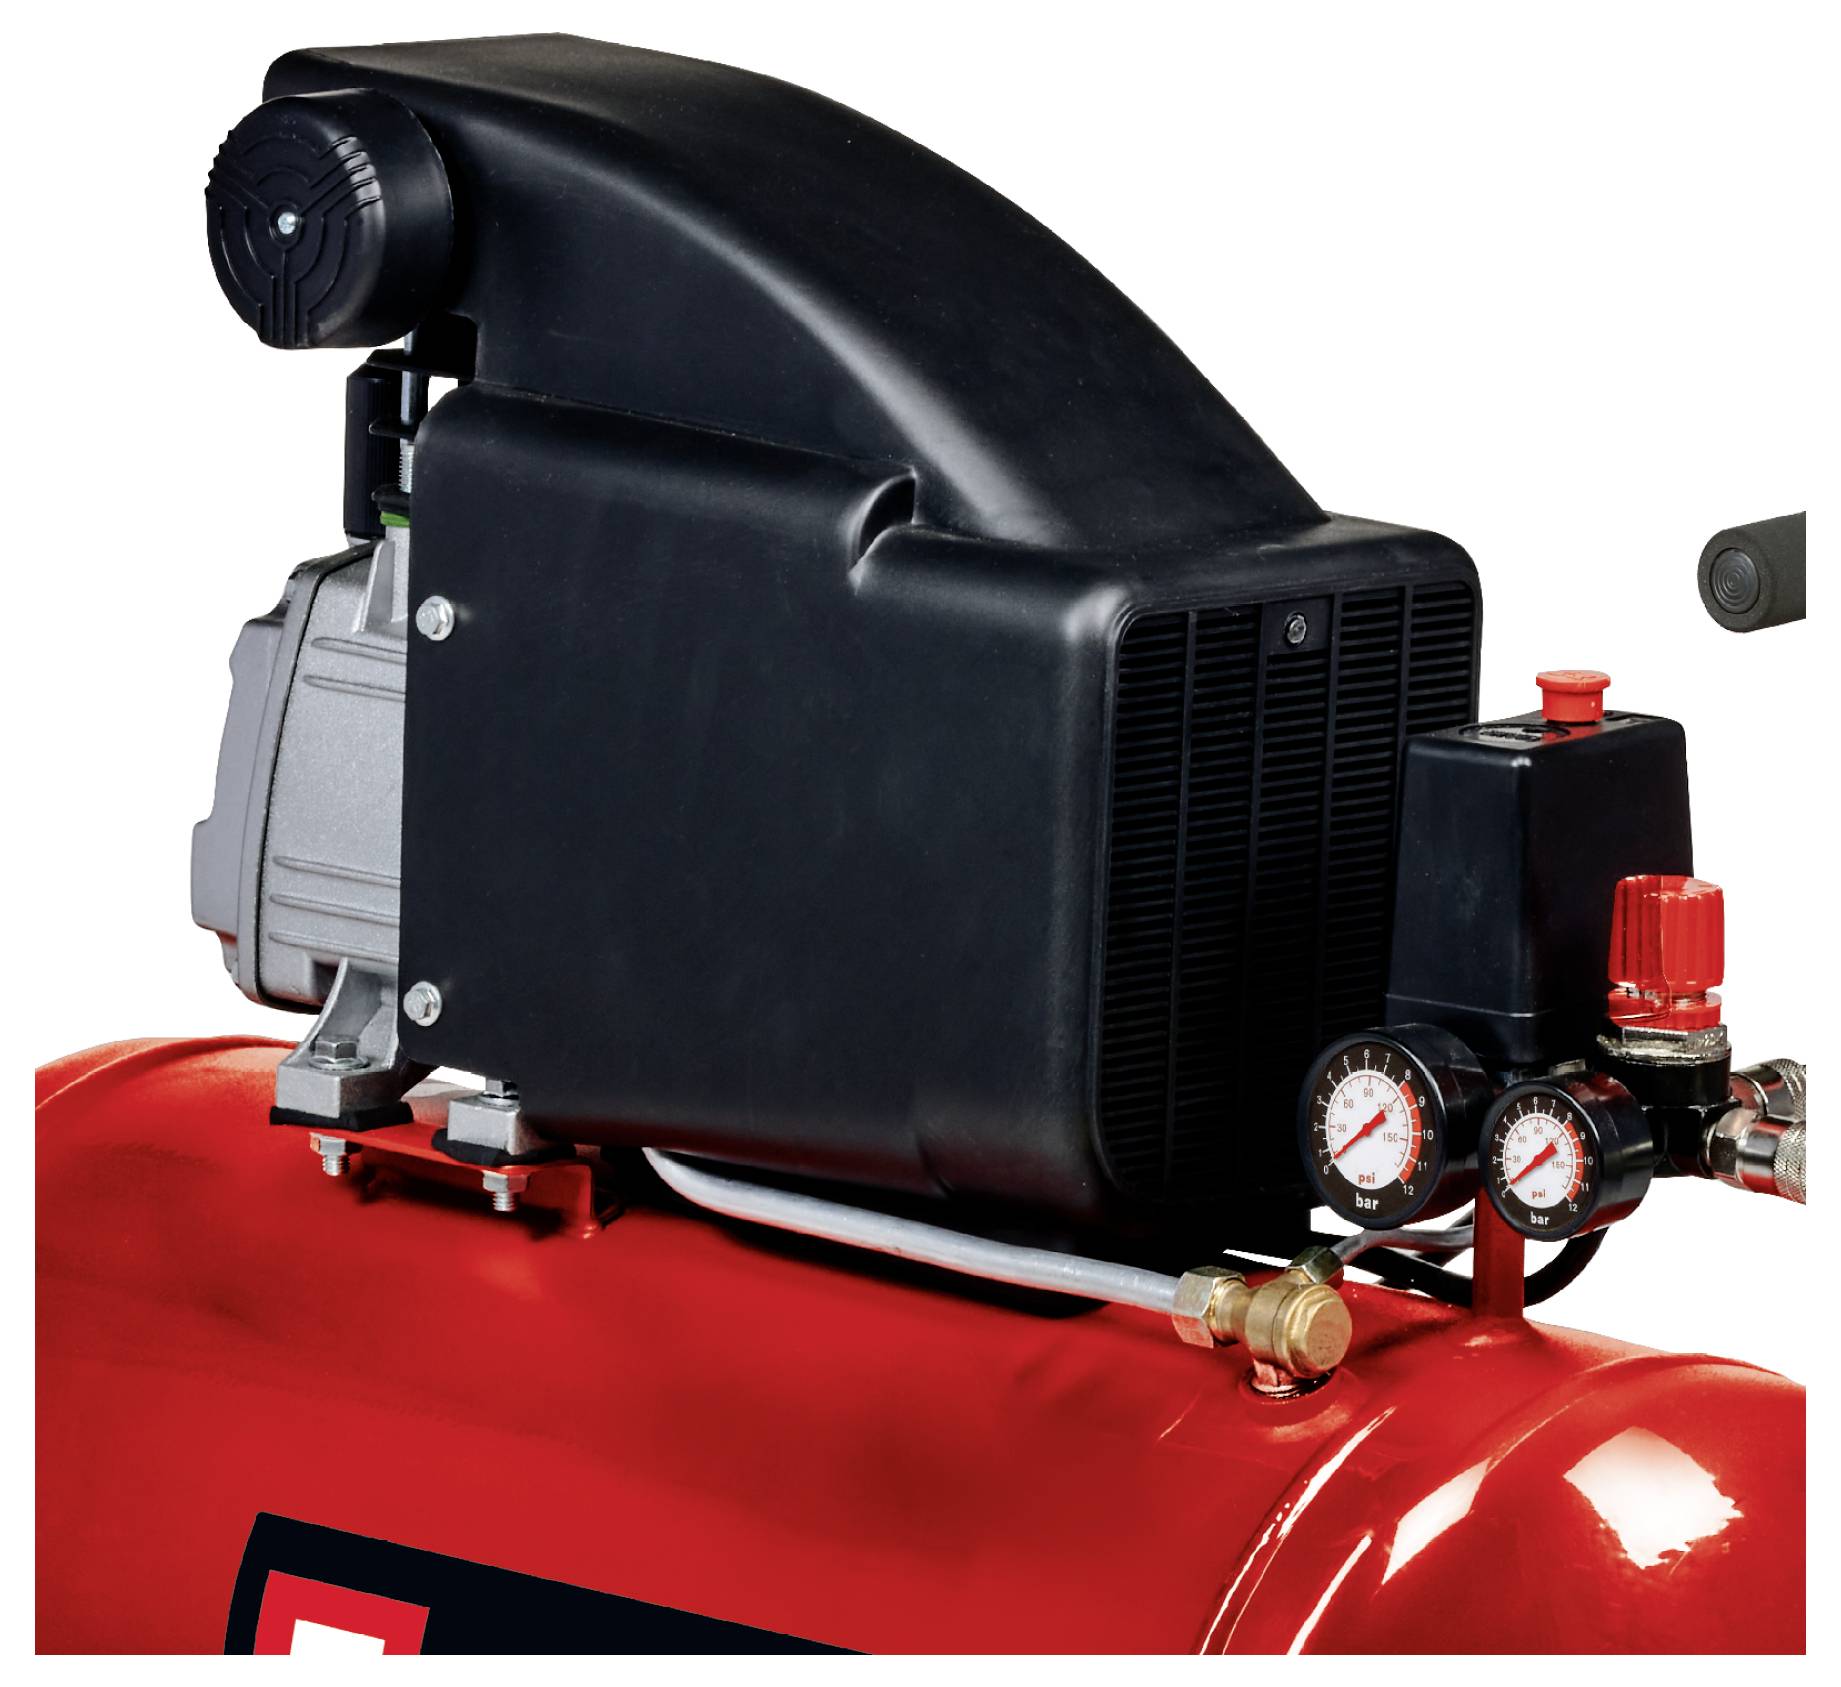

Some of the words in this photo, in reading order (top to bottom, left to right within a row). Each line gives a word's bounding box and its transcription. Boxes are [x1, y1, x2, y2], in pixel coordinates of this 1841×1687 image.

[1364, 1050, 1370, 1058] 6
[1385, 1054, 1391, 1062] 7
[1344, 1056, 1348, 1065] 5
[1327, 1072, 1332, 1080] 4
[1405, 1069, 1411, 1079] 8
[1363, 1088, 1373, 1097] 90
[1317, 1096, 1323, 1104] 3
[1344, 1099, 1353, 1109] 60
[1419, 1097, 1425, 1107] 9
[1533, 1097, 1538, 1105] 6
[1378, 1103, 1393, 1112] 120
[1314, 1123, 1318, 1131] 2
[1337, 1124, 1346, 1132] 30
[1383, 1132, 1397, 1143] 150
[1422, 1130, 1434, 1139] 10
[1580, 1132, 1585, 1140] 9
[1584, 1157, 1593, 1165] 10
[1323, 1166, 1328, 1174] 0
[1418, 1161, 1426, 1171] 11
[1358, 1172, 1375, 1185] psi
[1403, 1185, 1413, 1196] 12
[1532, 1190, 1546, 1198] psi
[1356, 1193, 1379, 1210] bar
[1569, 1203, 1577, 1212] 12
[1531, 1211, 1550, 1225] bar
